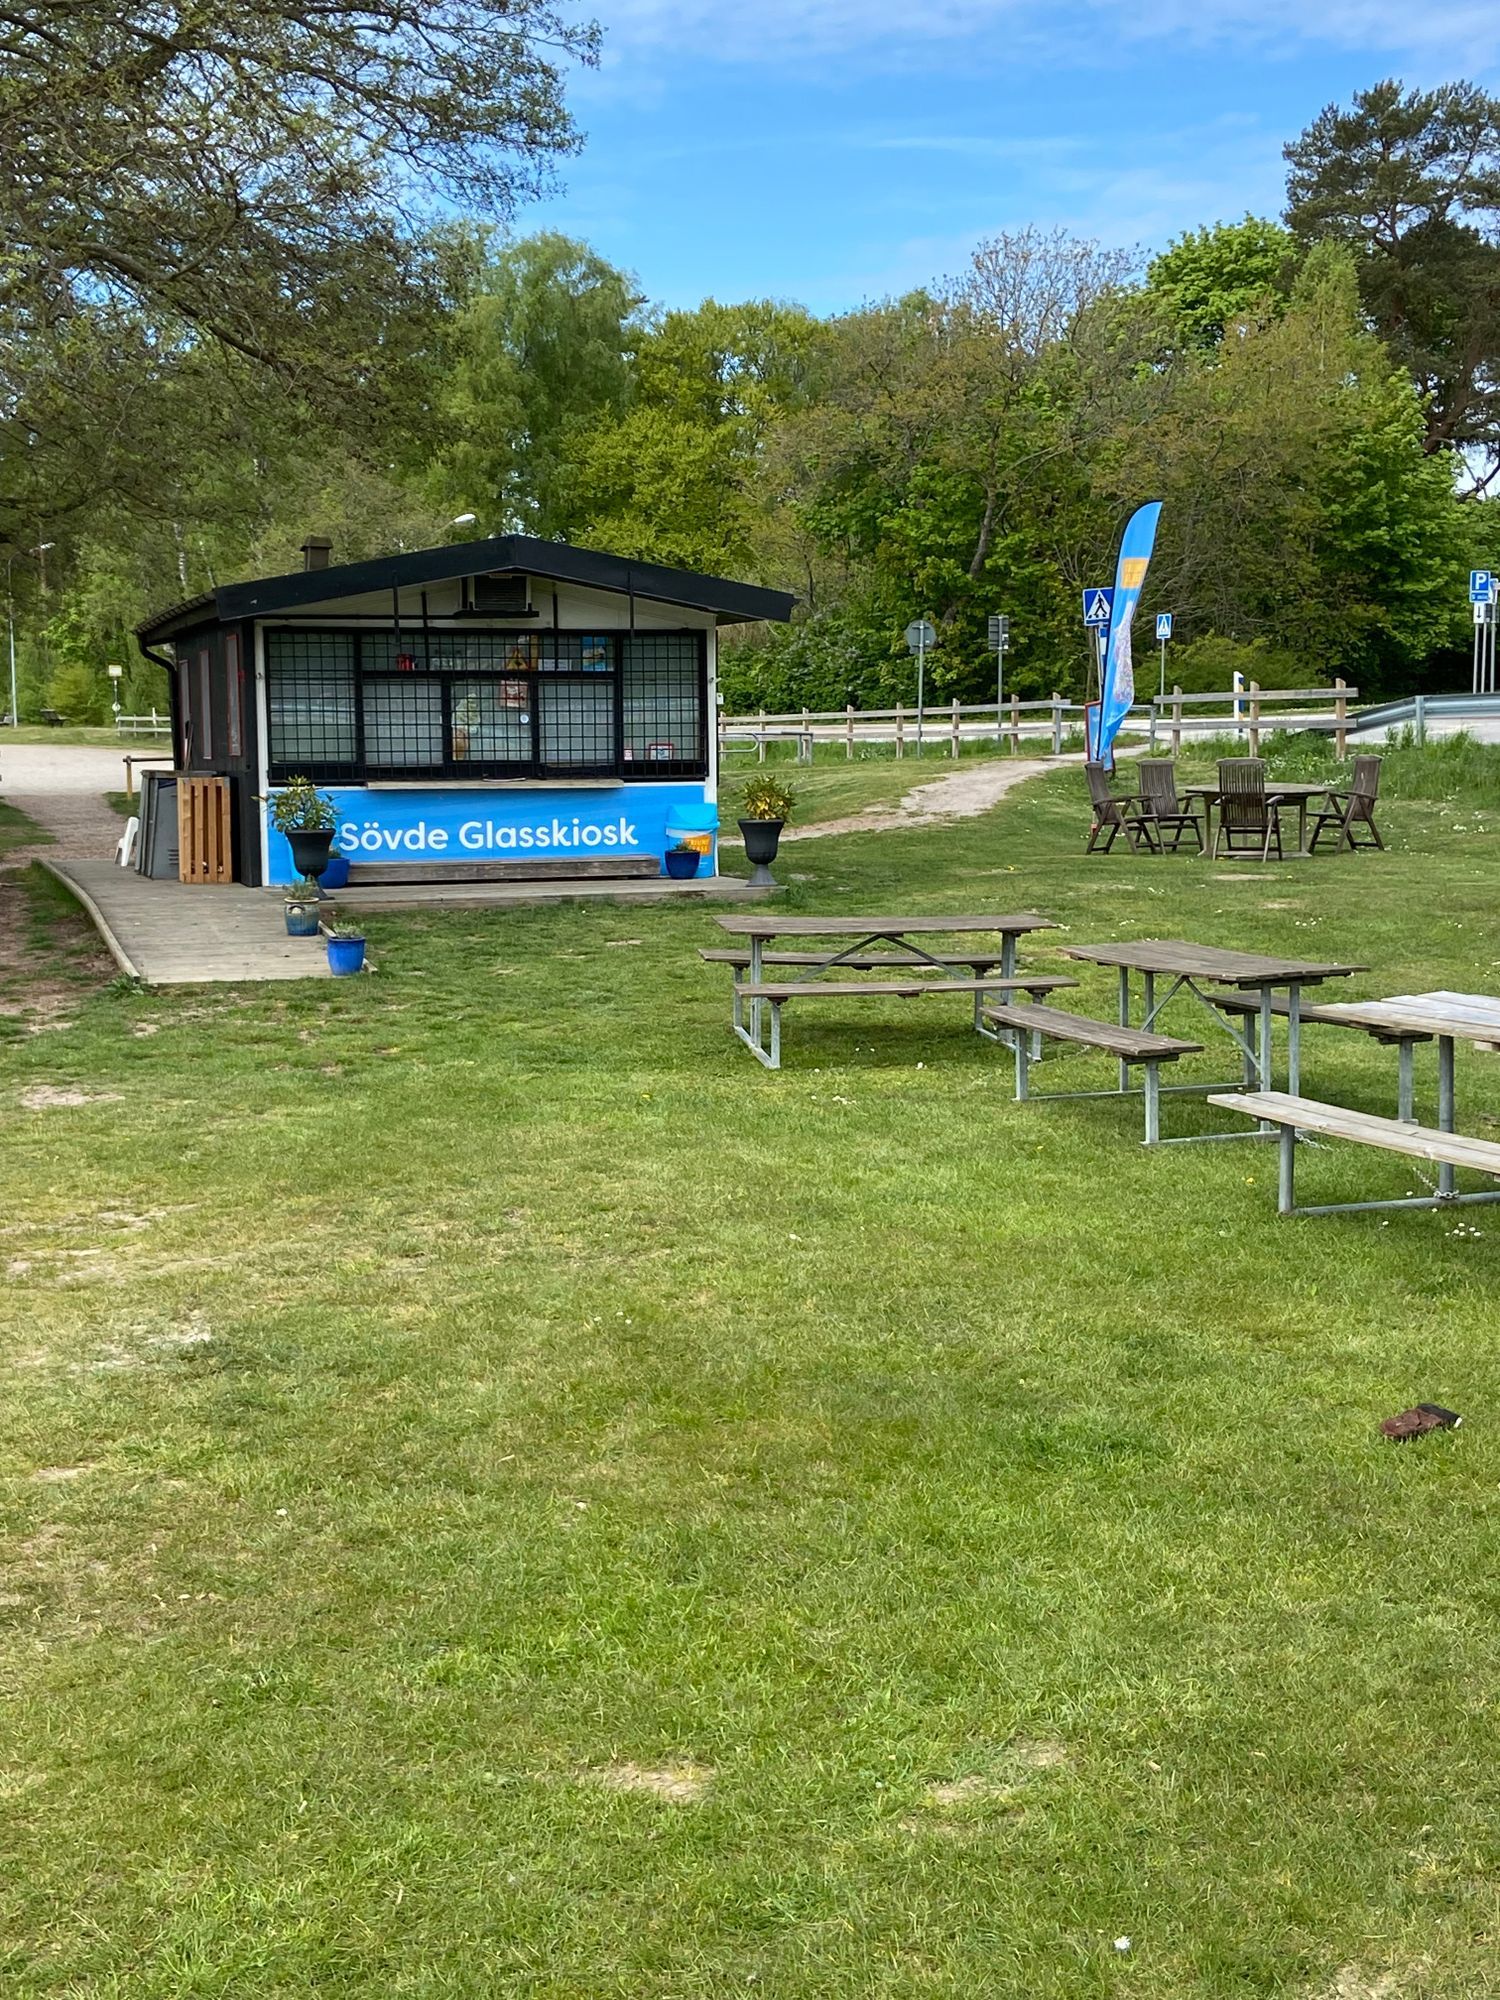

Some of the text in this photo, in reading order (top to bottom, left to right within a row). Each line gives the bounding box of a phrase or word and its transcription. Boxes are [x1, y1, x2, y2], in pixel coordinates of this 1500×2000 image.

[1475, 573, 1487, 590] P
[340, 817, 639, 851] Sövde Glasskiosk
